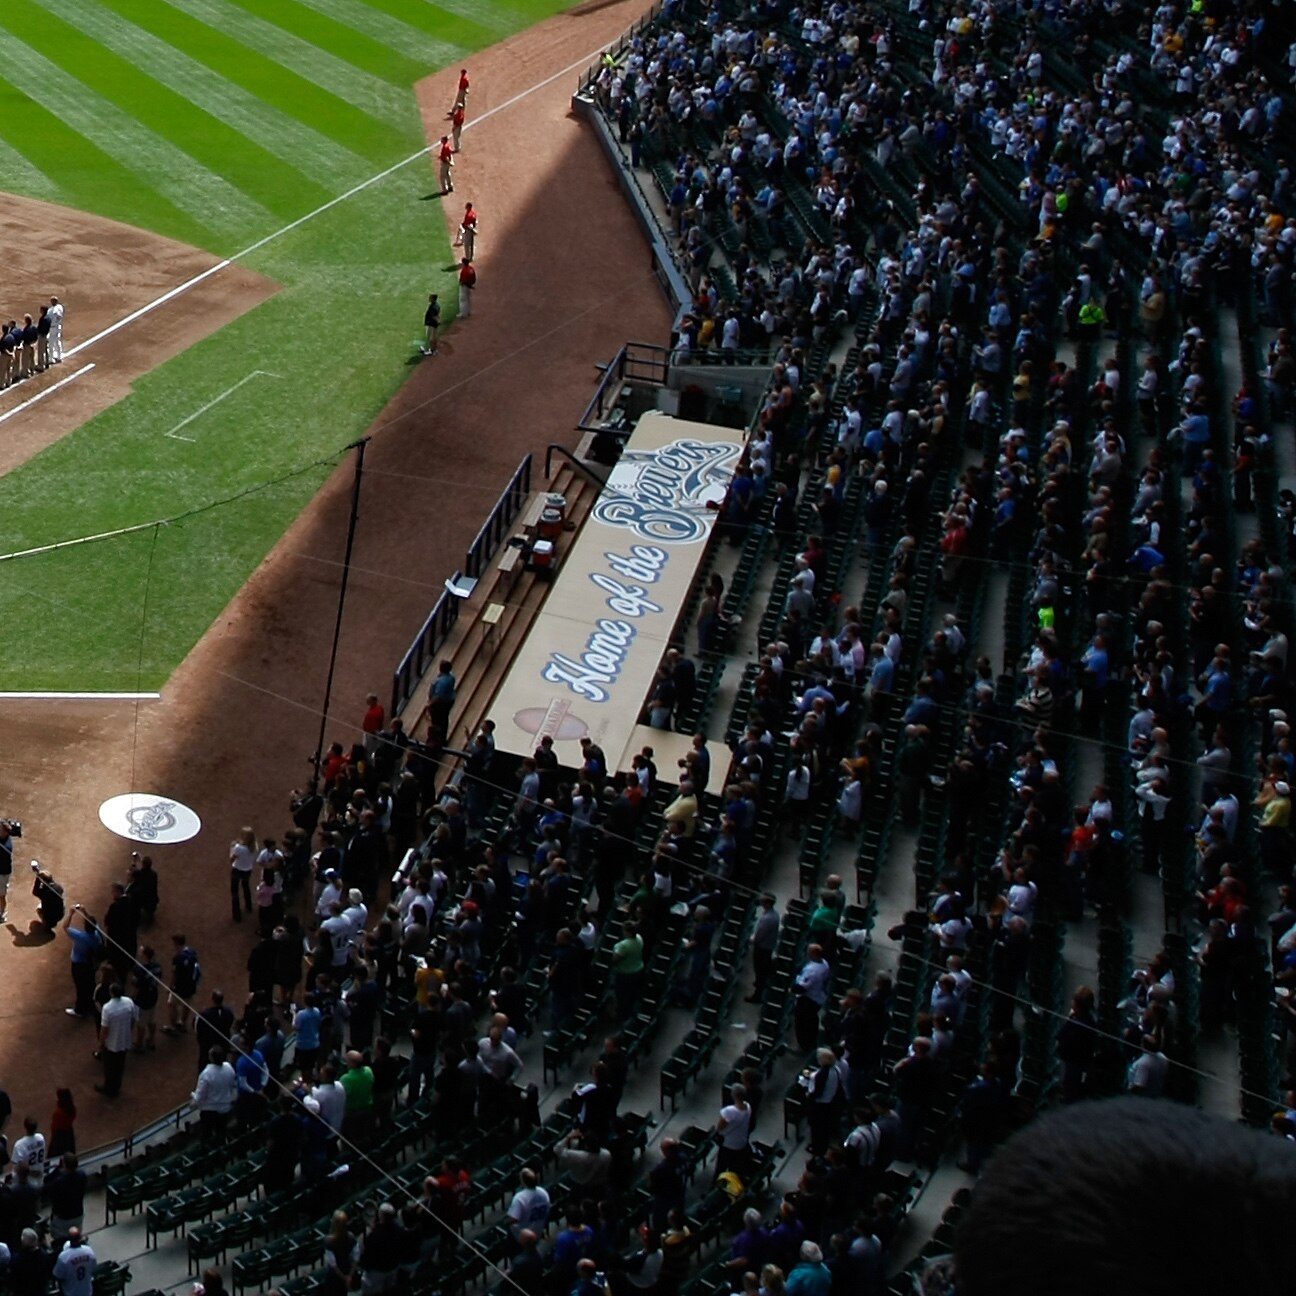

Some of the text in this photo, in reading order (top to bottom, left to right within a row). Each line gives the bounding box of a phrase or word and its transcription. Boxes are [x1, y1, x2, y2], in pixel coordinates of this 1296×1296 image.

[591, 439, 743, 544] Brewers
[588, 571, 664, 618] of
[604, 544, 669, 584] the
[541, 618, 638, 703] Home
